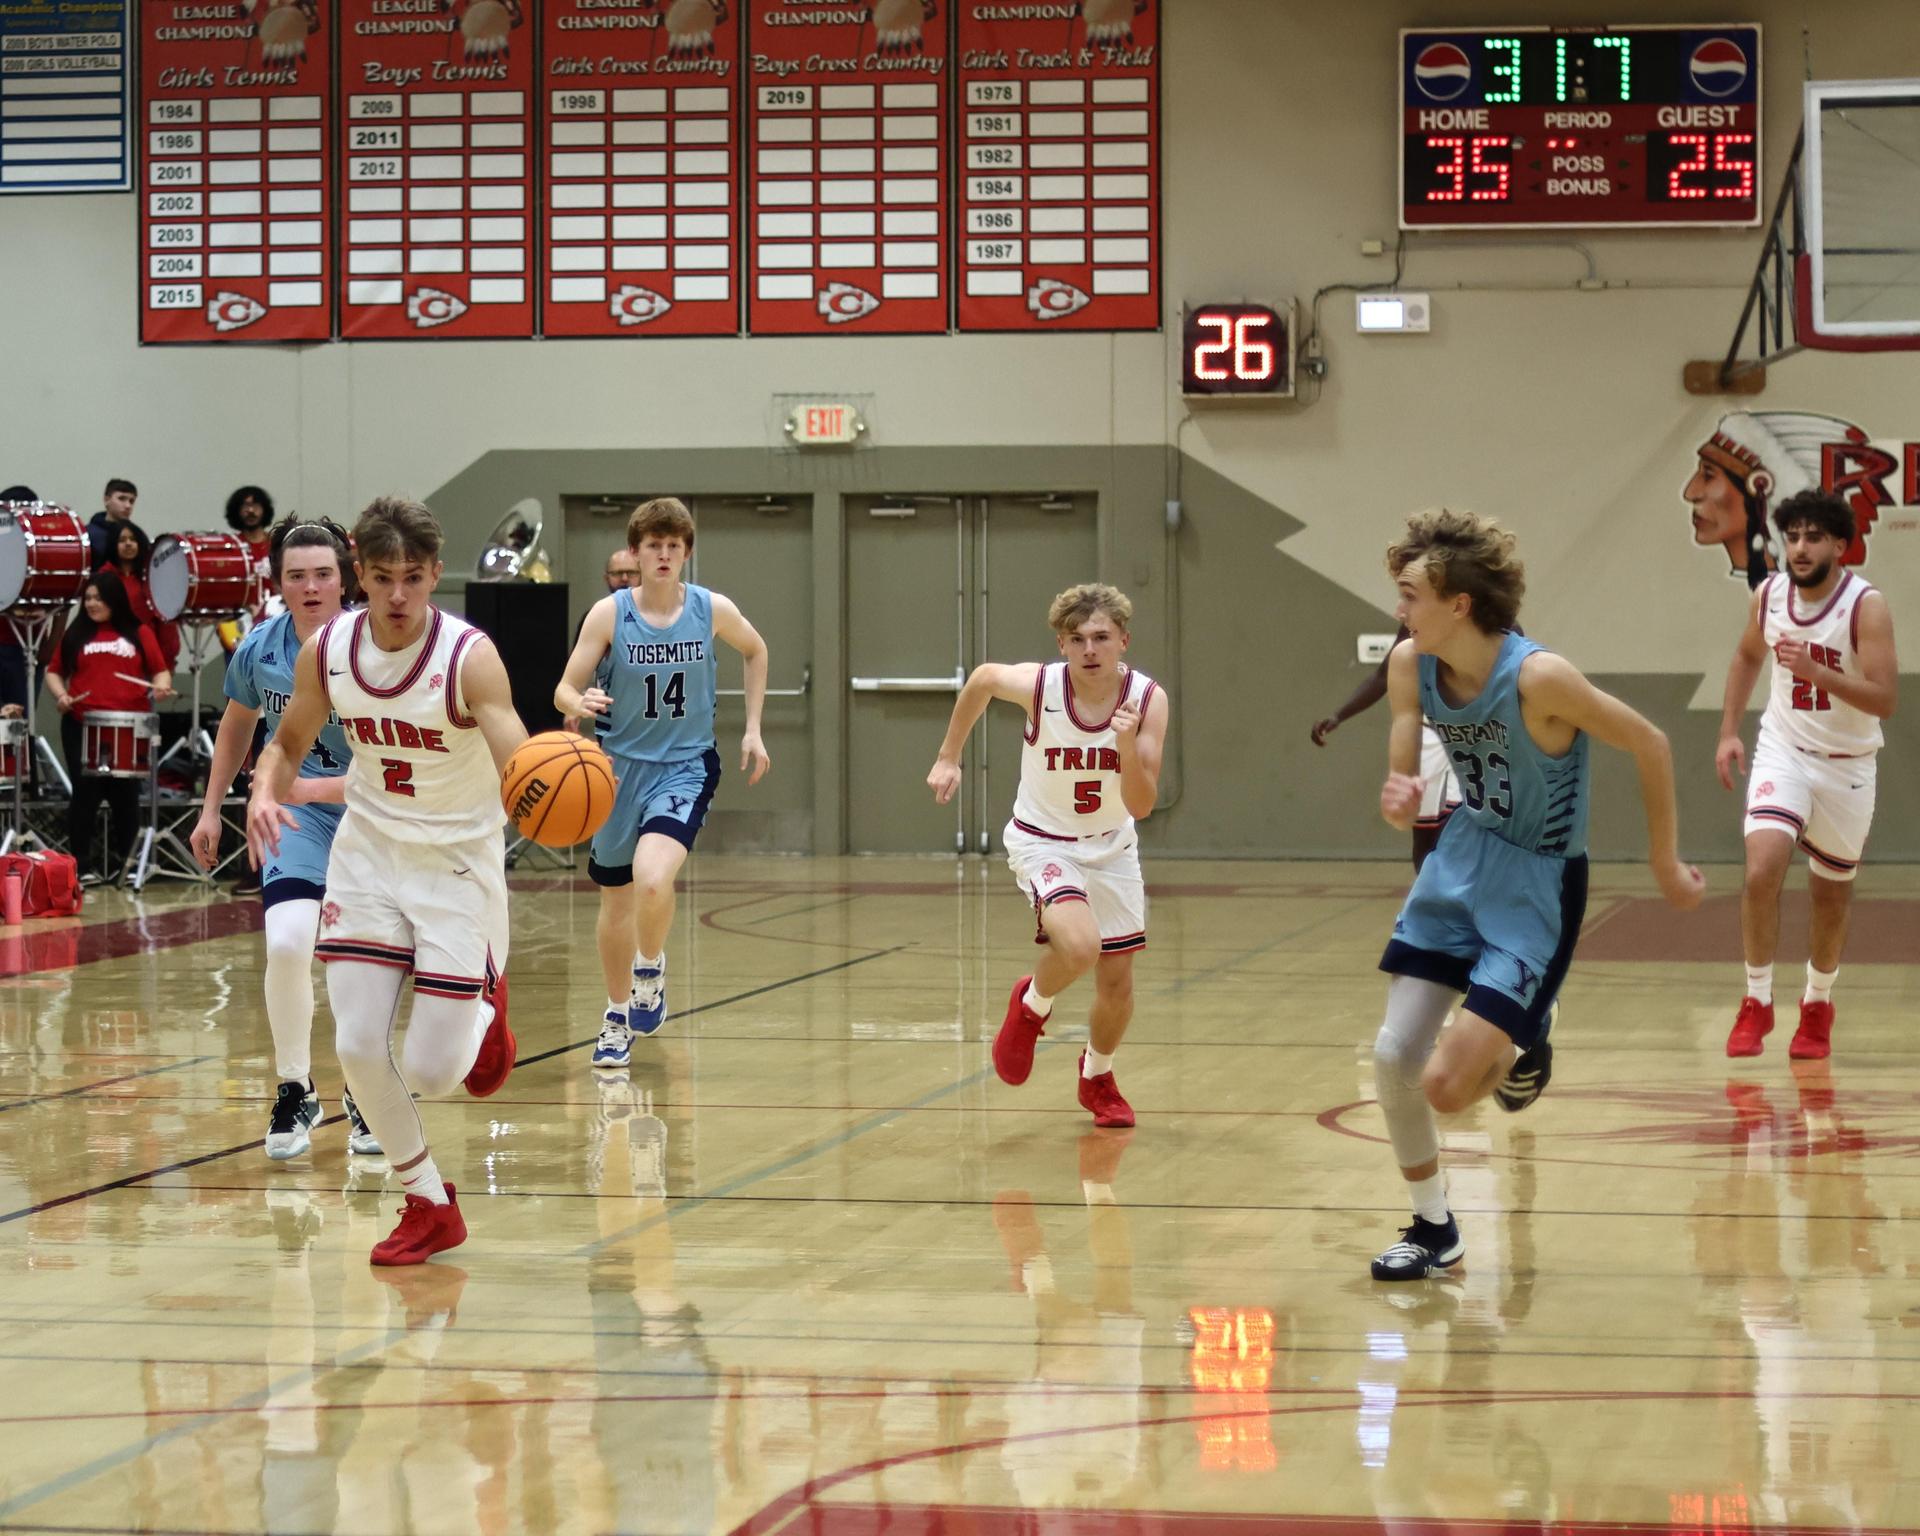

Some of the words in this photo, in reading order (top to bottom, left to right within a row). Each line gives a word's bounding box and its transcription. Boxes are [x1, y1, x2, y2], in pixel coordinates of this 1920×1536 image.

[173, 6, 237, 20] LEAGUE
[372, 0, 438, 14] LEAGUE
[973, 5, 1077, 20] CHAMPIONS
[558, 14, 659, 29] CHAMPIONS
[764, 10, 867, 26] CHAMPIONS
[155, 25, 255, 40] CHAMPIONS
[355, 19, 456, 35] CHAMPIONS
[28, 37, 54, 48] BOYS
[56, 36, 88, 48] WATER
[91, 35, 117, 46] POLO
[27, 58, 54, 70] GIRLS
[56, 56, 118, 69] VOLLEYBALL
[752, 54, 800, 77] Boys
[805, 53, 857, 72] Cross
[863, 53, 944, 75] Country
[962, 48, 1009, 70] Girls
[1016, 47, 1073, 69] Track
[1078, 48, 1094, 67] &
[1100, 46, 1154, 67] Field
[363, 61, 422, 86] Boys
[432, 60, 508, 80] Tennis
[552, 57, 594, 75] Girls
[600, 57, 649, 75] Cross
[655, 55, 730, 77] Country
[158, 67, 214, 88] Girls
[224, 65, 298, 86] Tennis
[767, 90, 805, 104] 2019
[975, 86, 1013, 100] 1978
[361, 101, 393, 114] 2009
[559, 95, 596, 109] 1998
[157, 105, 193, 118] 1984
[1657, 106, 1740, 128] GUEST
[976, 117, 1012, 131] 1981
[1419, 109, 1490, 130] HOME
[1544, 112, 1612, 129] PERIOD
[157, 135, 194, 148] 1986
[356, 132, 398, 145] 2011
[976, 149, 1013, 164] 1982
[360, 162, 396, 175] 2012
[1427, 138, 1508, 201] 35
[1552, 156, 1605, 173] POSS
[1669, 133, 1752, 198] 25
[157, 166, 193, 180] 2001
[976, 181, 1013, 195] 1984
[1546, 178, 1611, 196] BONUS
[157, 197, 194, 211] 2002
[976, 213, 1013, 227] 1986
[157, 228, 194, 242] 2003
[976, 244, 1013, 259] 1987
[157, 258, 194, 273] 2004
[157, 290, 195, 304] 2015
[1194, 314, 1273, 380] 26
[806, 408, 844, 437] EXIT
[627, 641, 705, 665] YOSEMITE
[643, 671, 687, 721] 14
[1792, 675, 1832, 711] 21
[342, 717, 450, 753] TRIBE
[1044, 747, 1121, 773] TRIB
[381, 758, 415, 797] 2
[1453, 750, 1514, 820] 33
[667, 794, 689, 815] Y
[1074, 780, 1102, 814] 5
